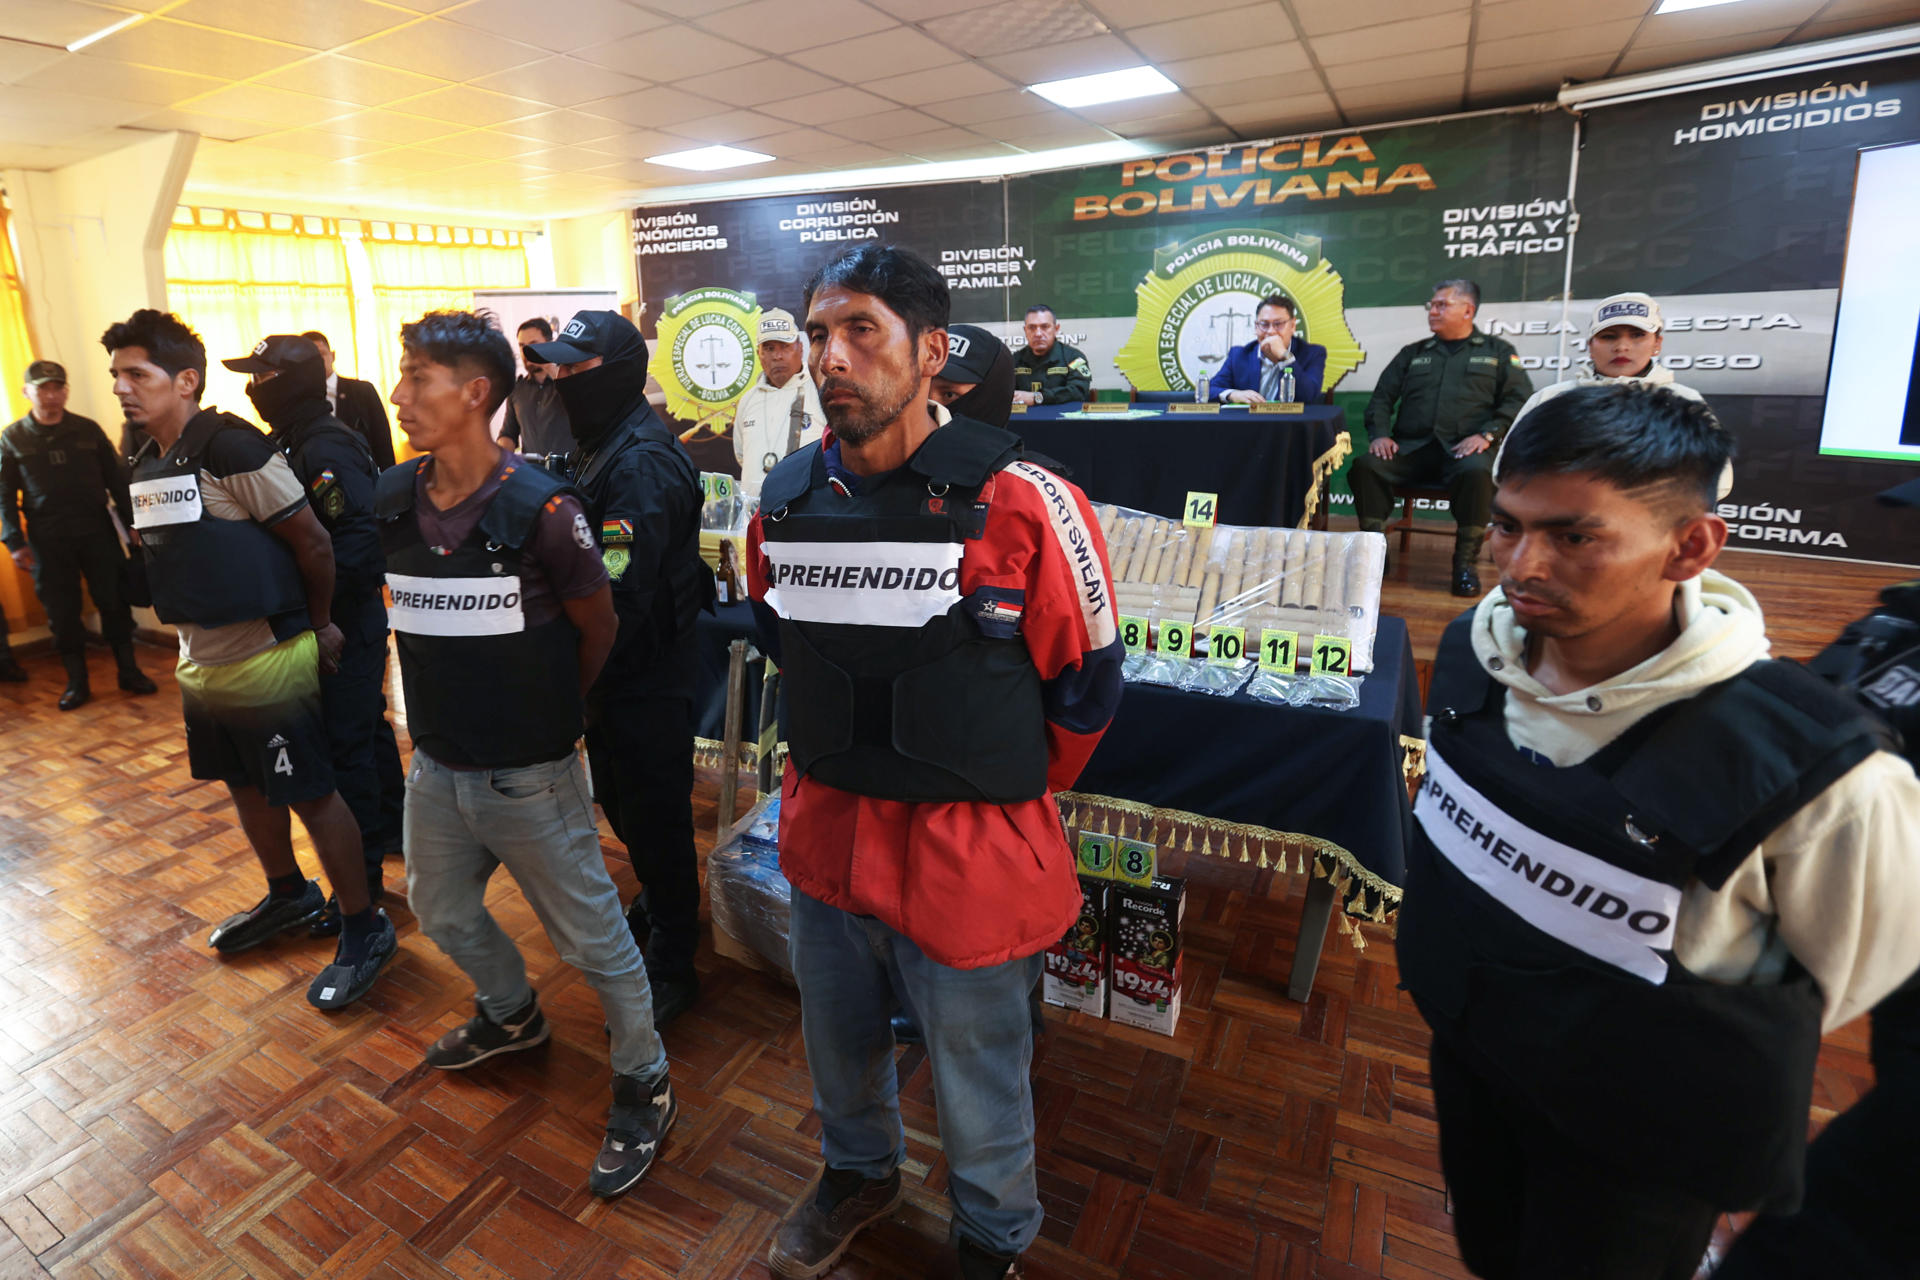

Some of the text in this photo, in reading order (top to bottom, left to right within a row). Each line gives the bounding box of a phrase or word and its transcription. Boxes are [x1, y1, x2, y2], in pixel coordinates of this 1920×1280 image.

[1700, 80, 1868, 122] DIVISIÓN
[1674, 98, 1901, 145] HOMICIDIOS
[1121, 135, 1376, 187] POLICIA
[1073, 163, 1438, 221] BOLIVIANA
[797, 197, 876, 216] DIVISIÓN
[1443, 198, 1567, 224] DIVISIÓN
[779, 209, 899, 231] CORRUPCIÓN
[1443, 221, 1538, 241] TRATA
[1543, 218, 1563, 234] Y
[632, 225, 719, 242] NÓMICOS
[800, 227, 878, 243] PÚBLICA
[634, 238, 728, 255] NANCIEROS
[941, 244, 1024, 262] DIVISIÓN
[1166, 235, 1309, 274] POLICIA BOLIVIANA
[1444, 237, 1564, 258] TRÁFICO
[1024, 259, 1036, 271] Y
[947, 275, 1022, 289] FAMILIA
[672, 291, 751, 315] POLICIA BOLIVIANA
[1160, 292, 1198, 349] ESPECIAL
[1195, 279, 1214, 299] DE
[1216, 273, 1260, 292] LUCHA
[690, 316, 702, 328] DE
[701, 313, 726, 325] LUCHA
[1484, 313, 1802, 336] ÍNEA ECTA
[673, 323, 693, 360] ESPECIAL
[726, 319, 752, 347] CONTRA
[673, 364, 694, 391] FUERZA
[736, 359, 753, 388] CRIMEN
[701, 389, 730, 400] BOLIVIA
[719, 480, 726, 495] 6
[1190, 499, 1213, 520] 14
[1716, 502, 1802, 524] SIÓN
[1015, 461, 1107, 617] SPORTSWEAR
[1726, 523, 1849, 548] FORMA
[1124, 623, 1139, 646] 8
[1167, 628, 1183, 652] 9
[1212, 633, 1241, 659] 10
[1267, 639, 1290, 665] 11
[1317, 645, 1346, 673] 12
[275, 747, 293, 776] 4
[1092, 844, 1101, 866] 1
[1126, 850, 1143, 874] 8
[1122, 897, 1166, 917] Recorde
[1114, 968, 1170, 998] 19x4
